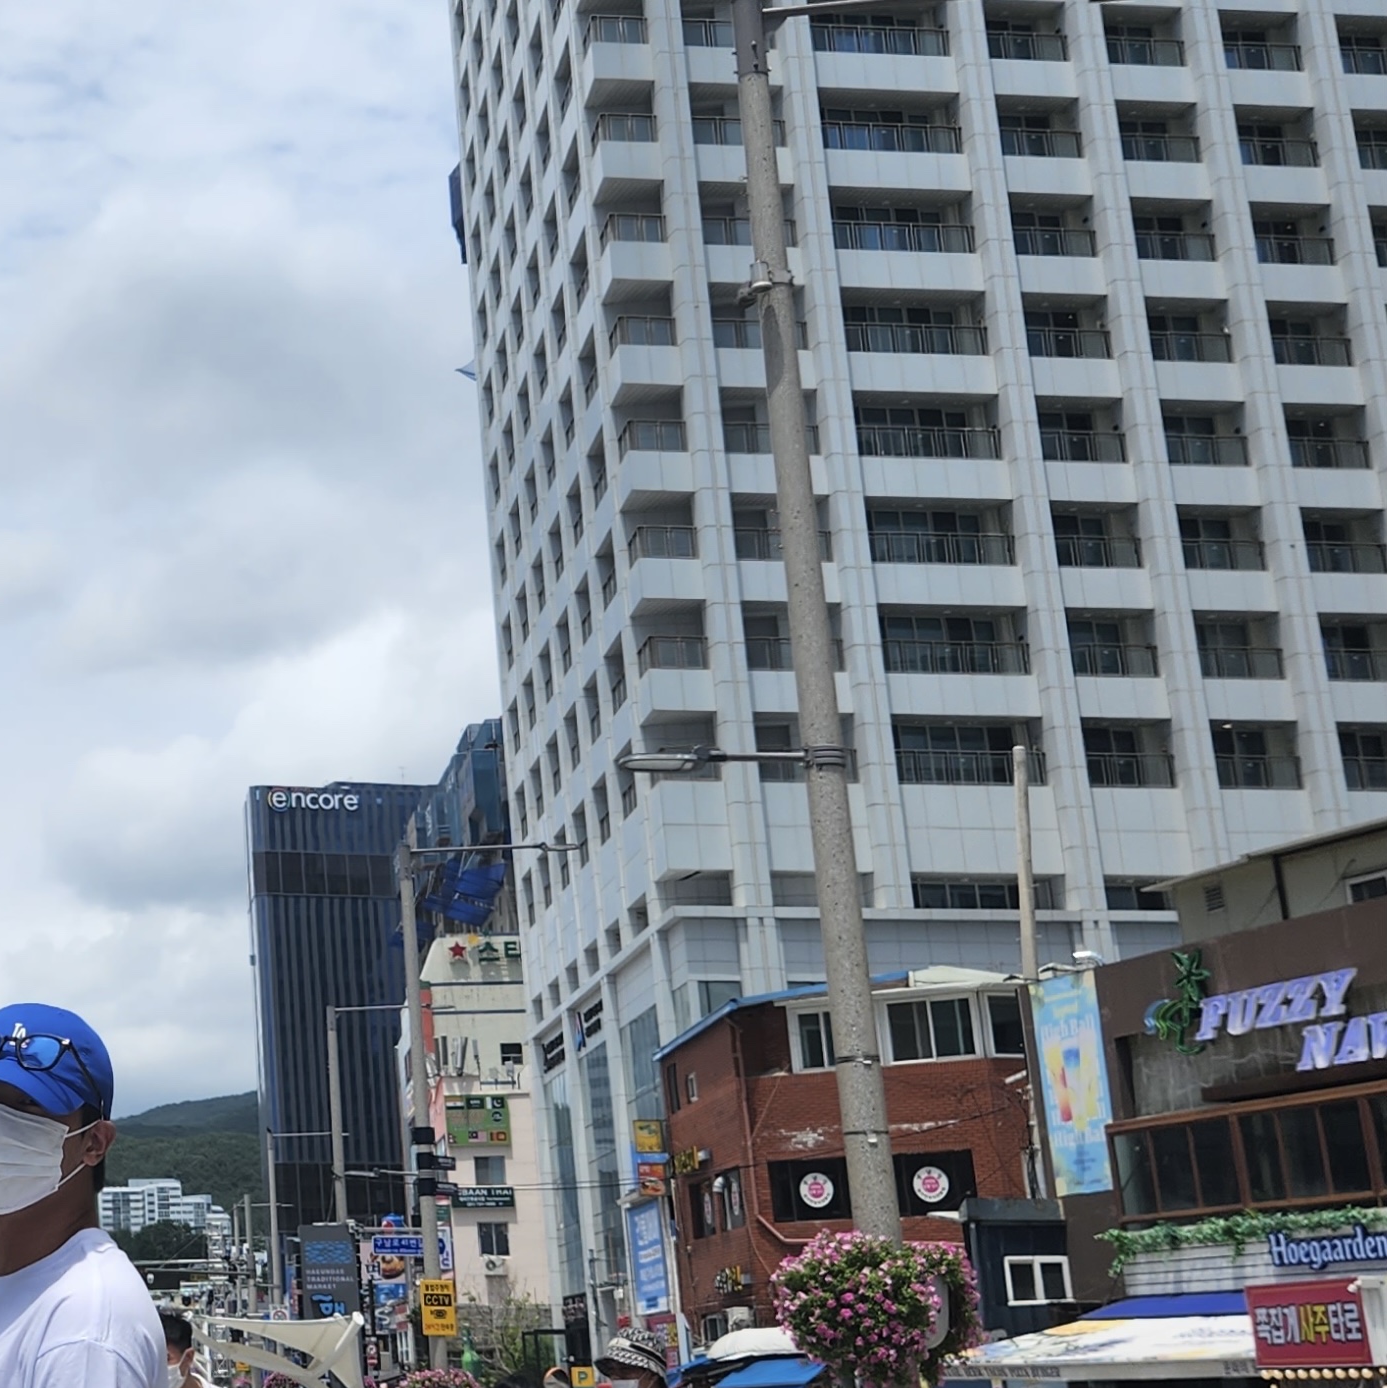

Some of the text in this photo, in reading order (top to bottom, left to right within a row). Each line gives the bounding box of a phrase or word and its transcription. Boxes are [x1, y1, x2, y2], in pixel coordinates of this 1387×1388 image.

[268, 788, 359, 812] encore
[1195, 968, 1358, 1041] FUZZY
[1269, 1226, 1387, 1269] Hoegaarden
[425, 1295, 450, 1305] CCTV
[577, 1371, 589, 1384] P
